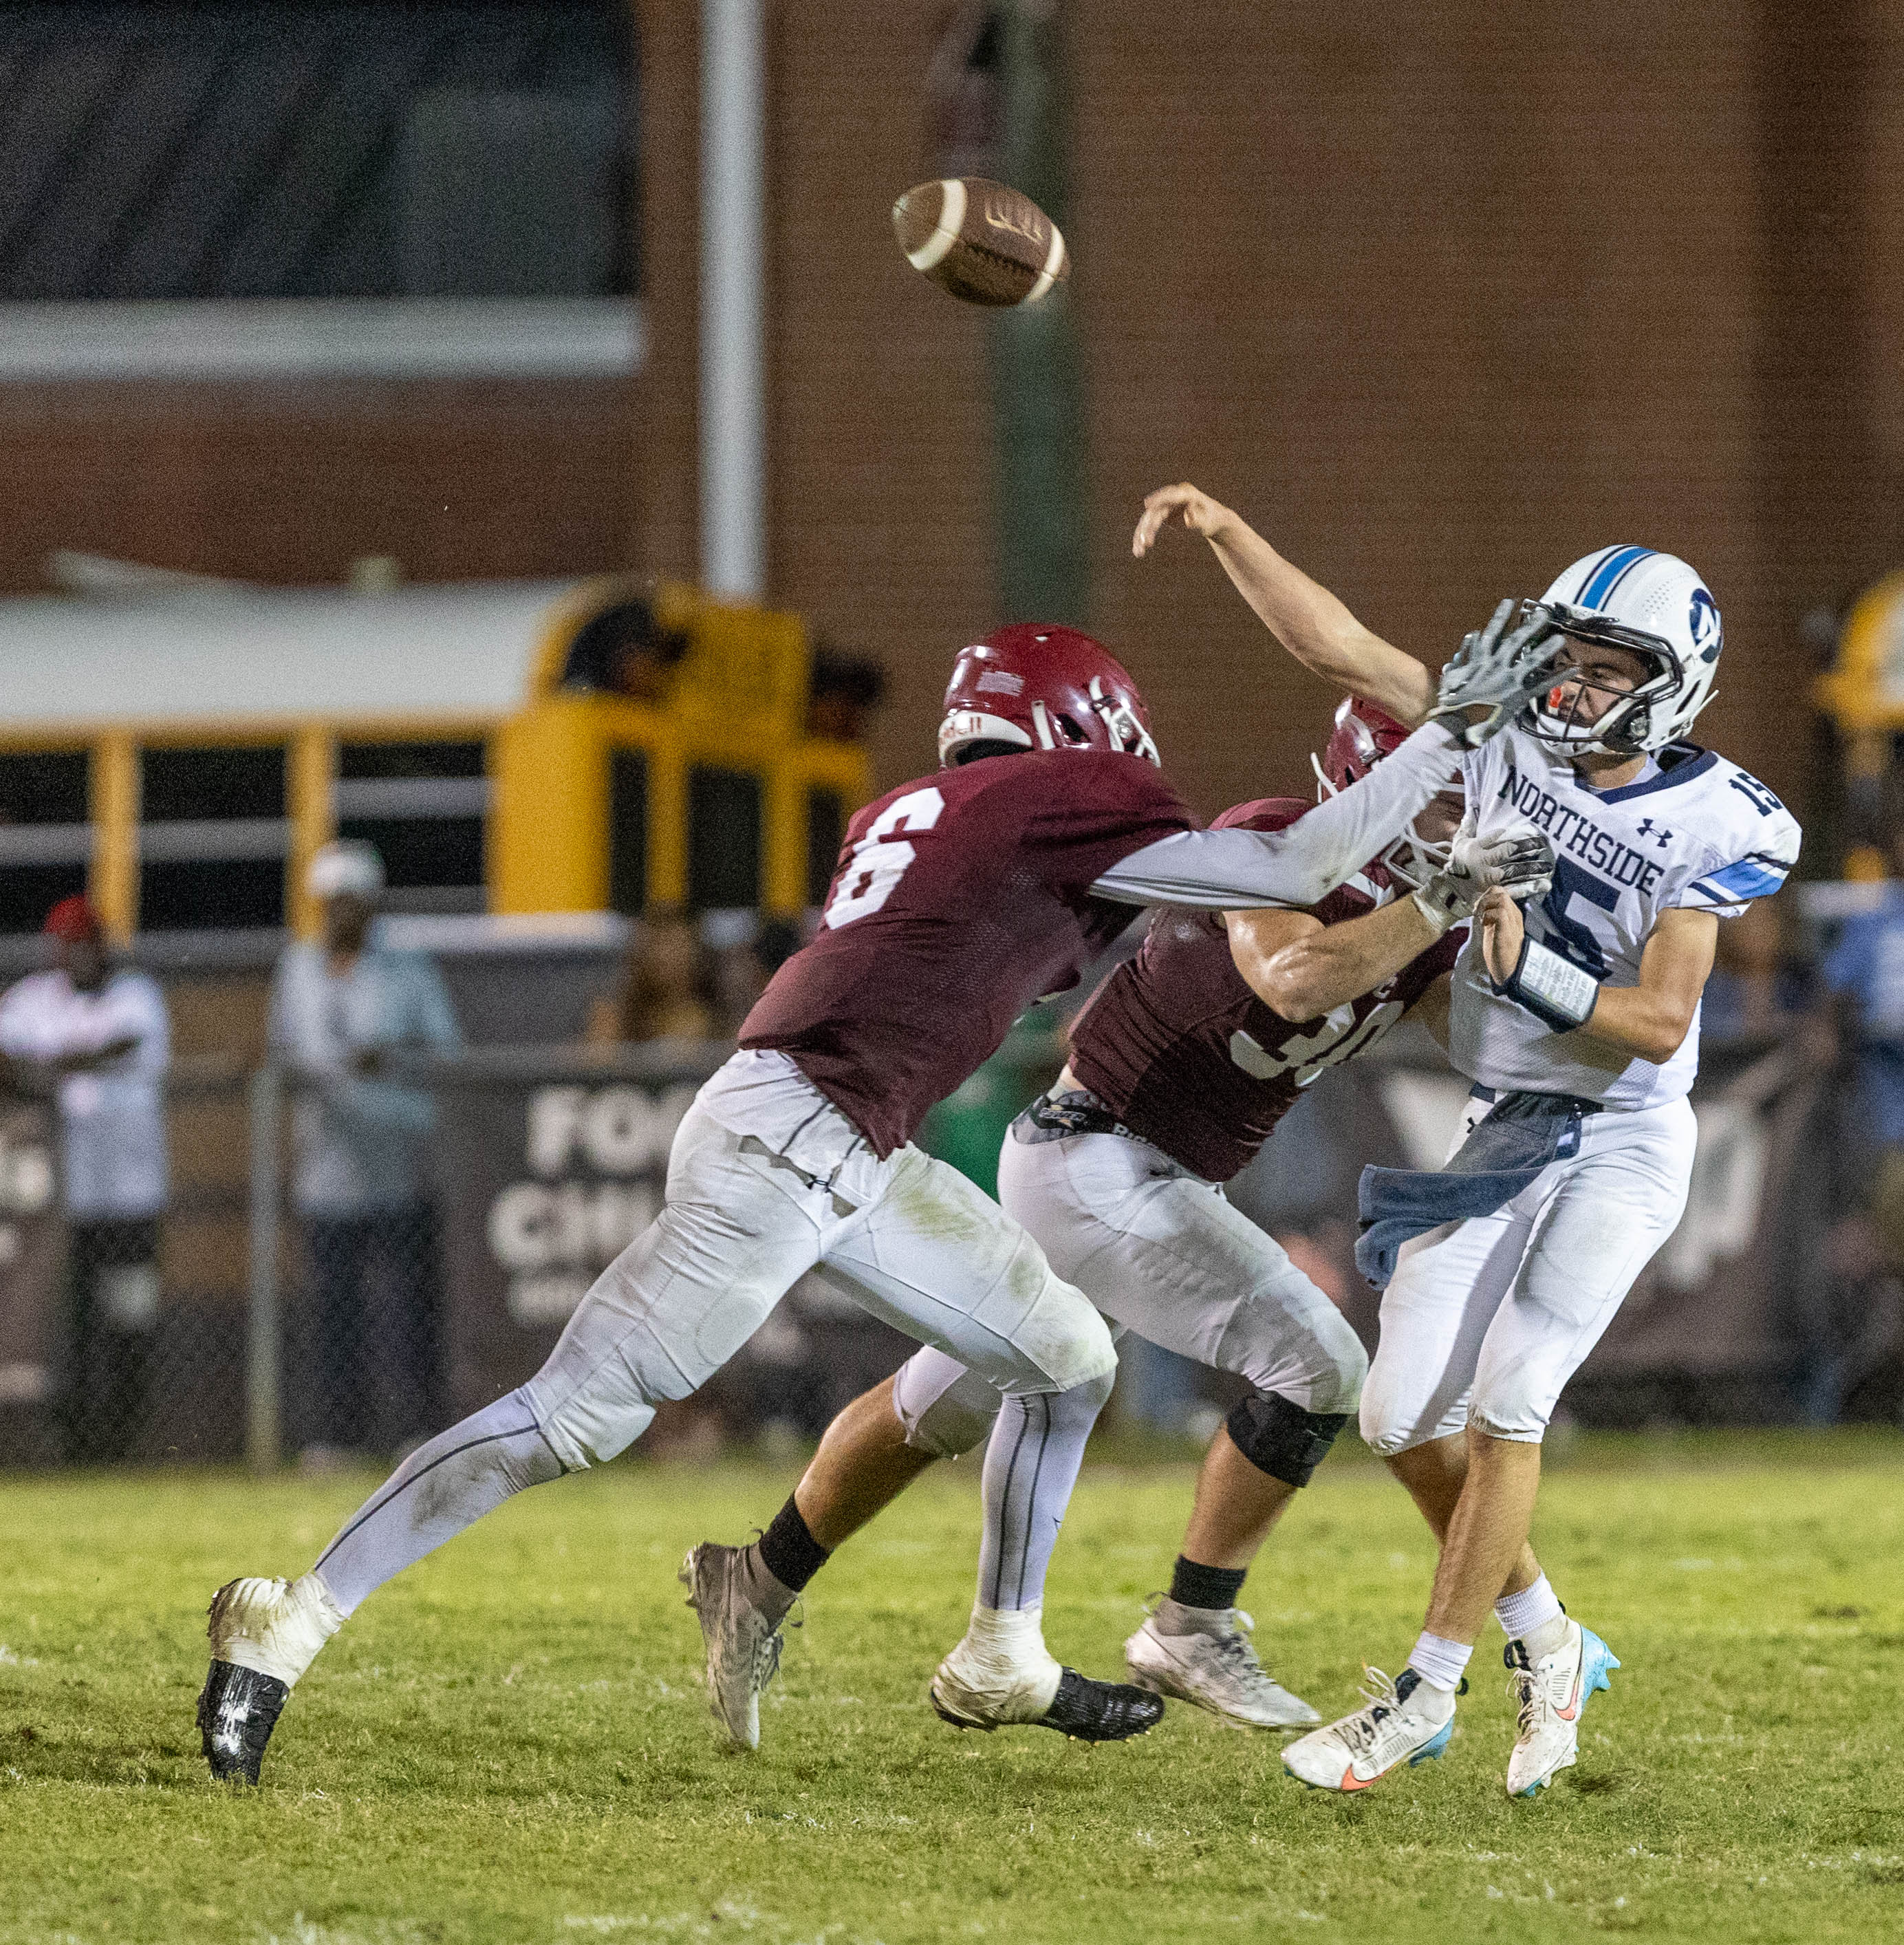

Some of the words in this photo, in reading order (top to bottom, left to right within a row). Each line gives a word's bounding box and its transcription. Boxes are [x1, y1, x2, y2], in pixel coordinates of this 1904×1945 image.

[825, 787, 945, 929] 6
[1498, 765, 1665, 894] NORTHSIDE
[1728, 773, 1783, 817] 15
